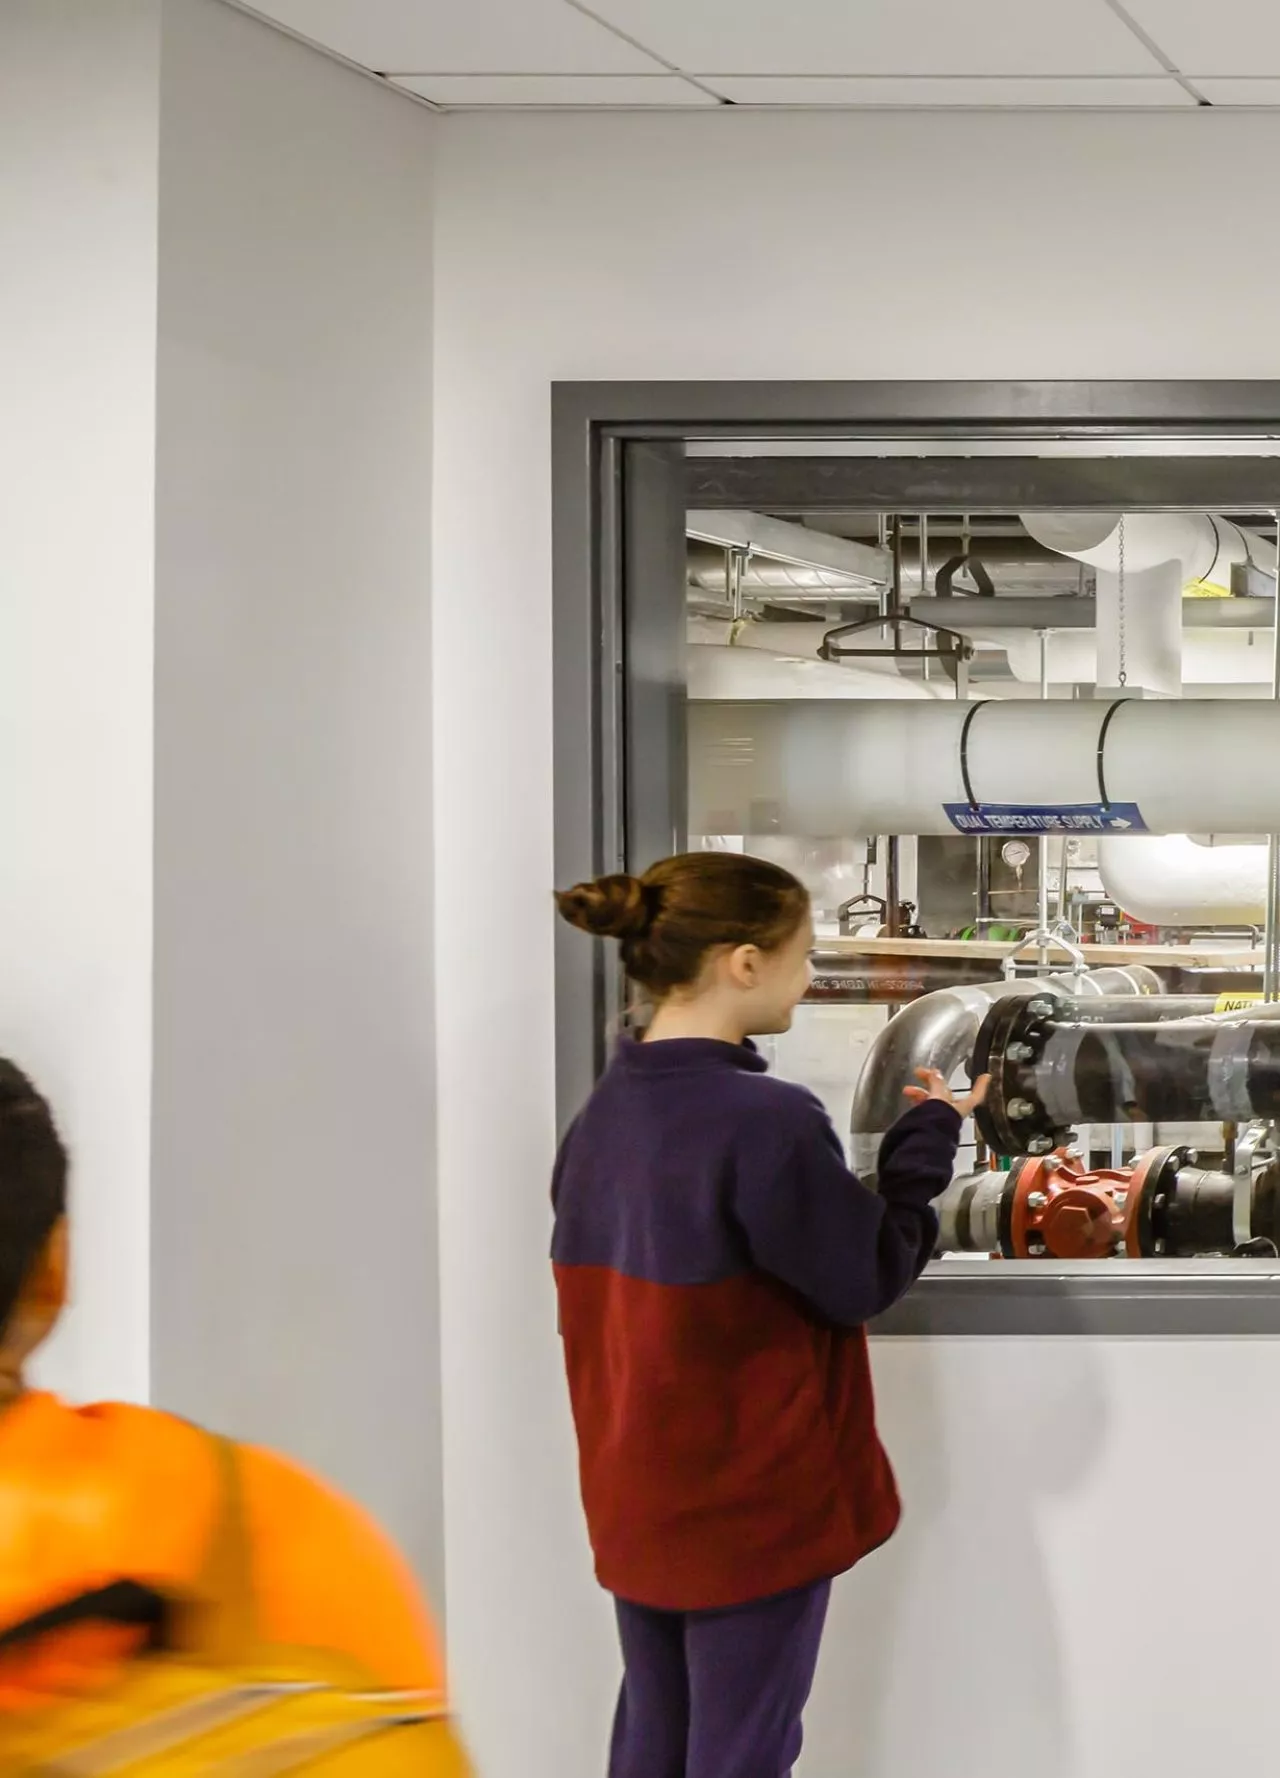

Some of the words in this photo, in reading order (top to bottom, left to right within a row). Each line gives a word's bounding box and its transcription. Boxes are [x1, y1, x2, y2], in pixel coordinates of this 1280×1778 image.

[955, 814, 989, 829] DUAL
[984, 814, 1064, 829] TEMPERATURE
[1060, 814, 1105, 829] SUPPLY
